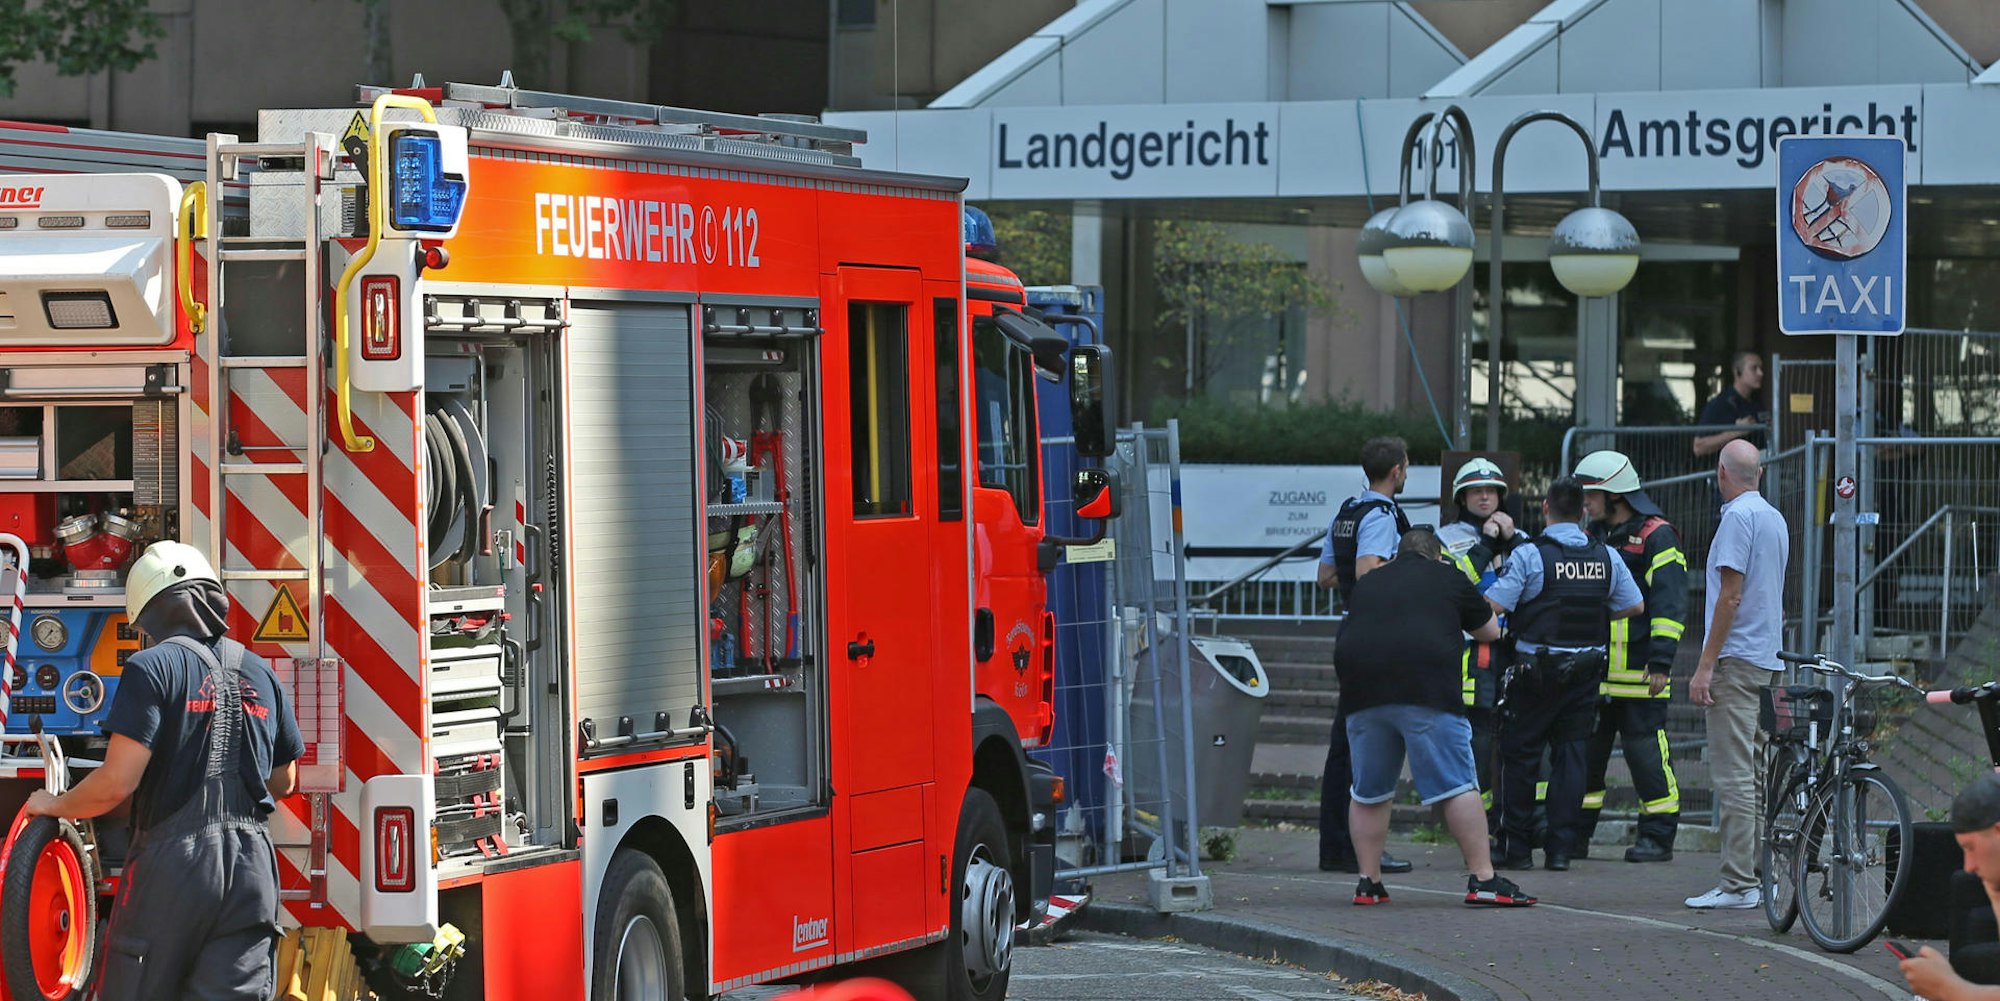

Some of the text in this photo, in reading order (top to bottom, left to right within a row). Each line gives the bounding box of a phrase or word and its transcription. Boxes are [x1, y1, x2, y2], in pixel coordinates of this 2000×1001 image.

[999, 118, 1269, 180] Landgericht
[535, 192, 760, 268] FEUERWEHR 112
[1789, 275, 1892, 315] TAXI
[1268, 491, 1327, 506] ZUGANG
[1555, 562, 1606, 580] POLIZEI
[793, 915, 829, 953] Lentner
